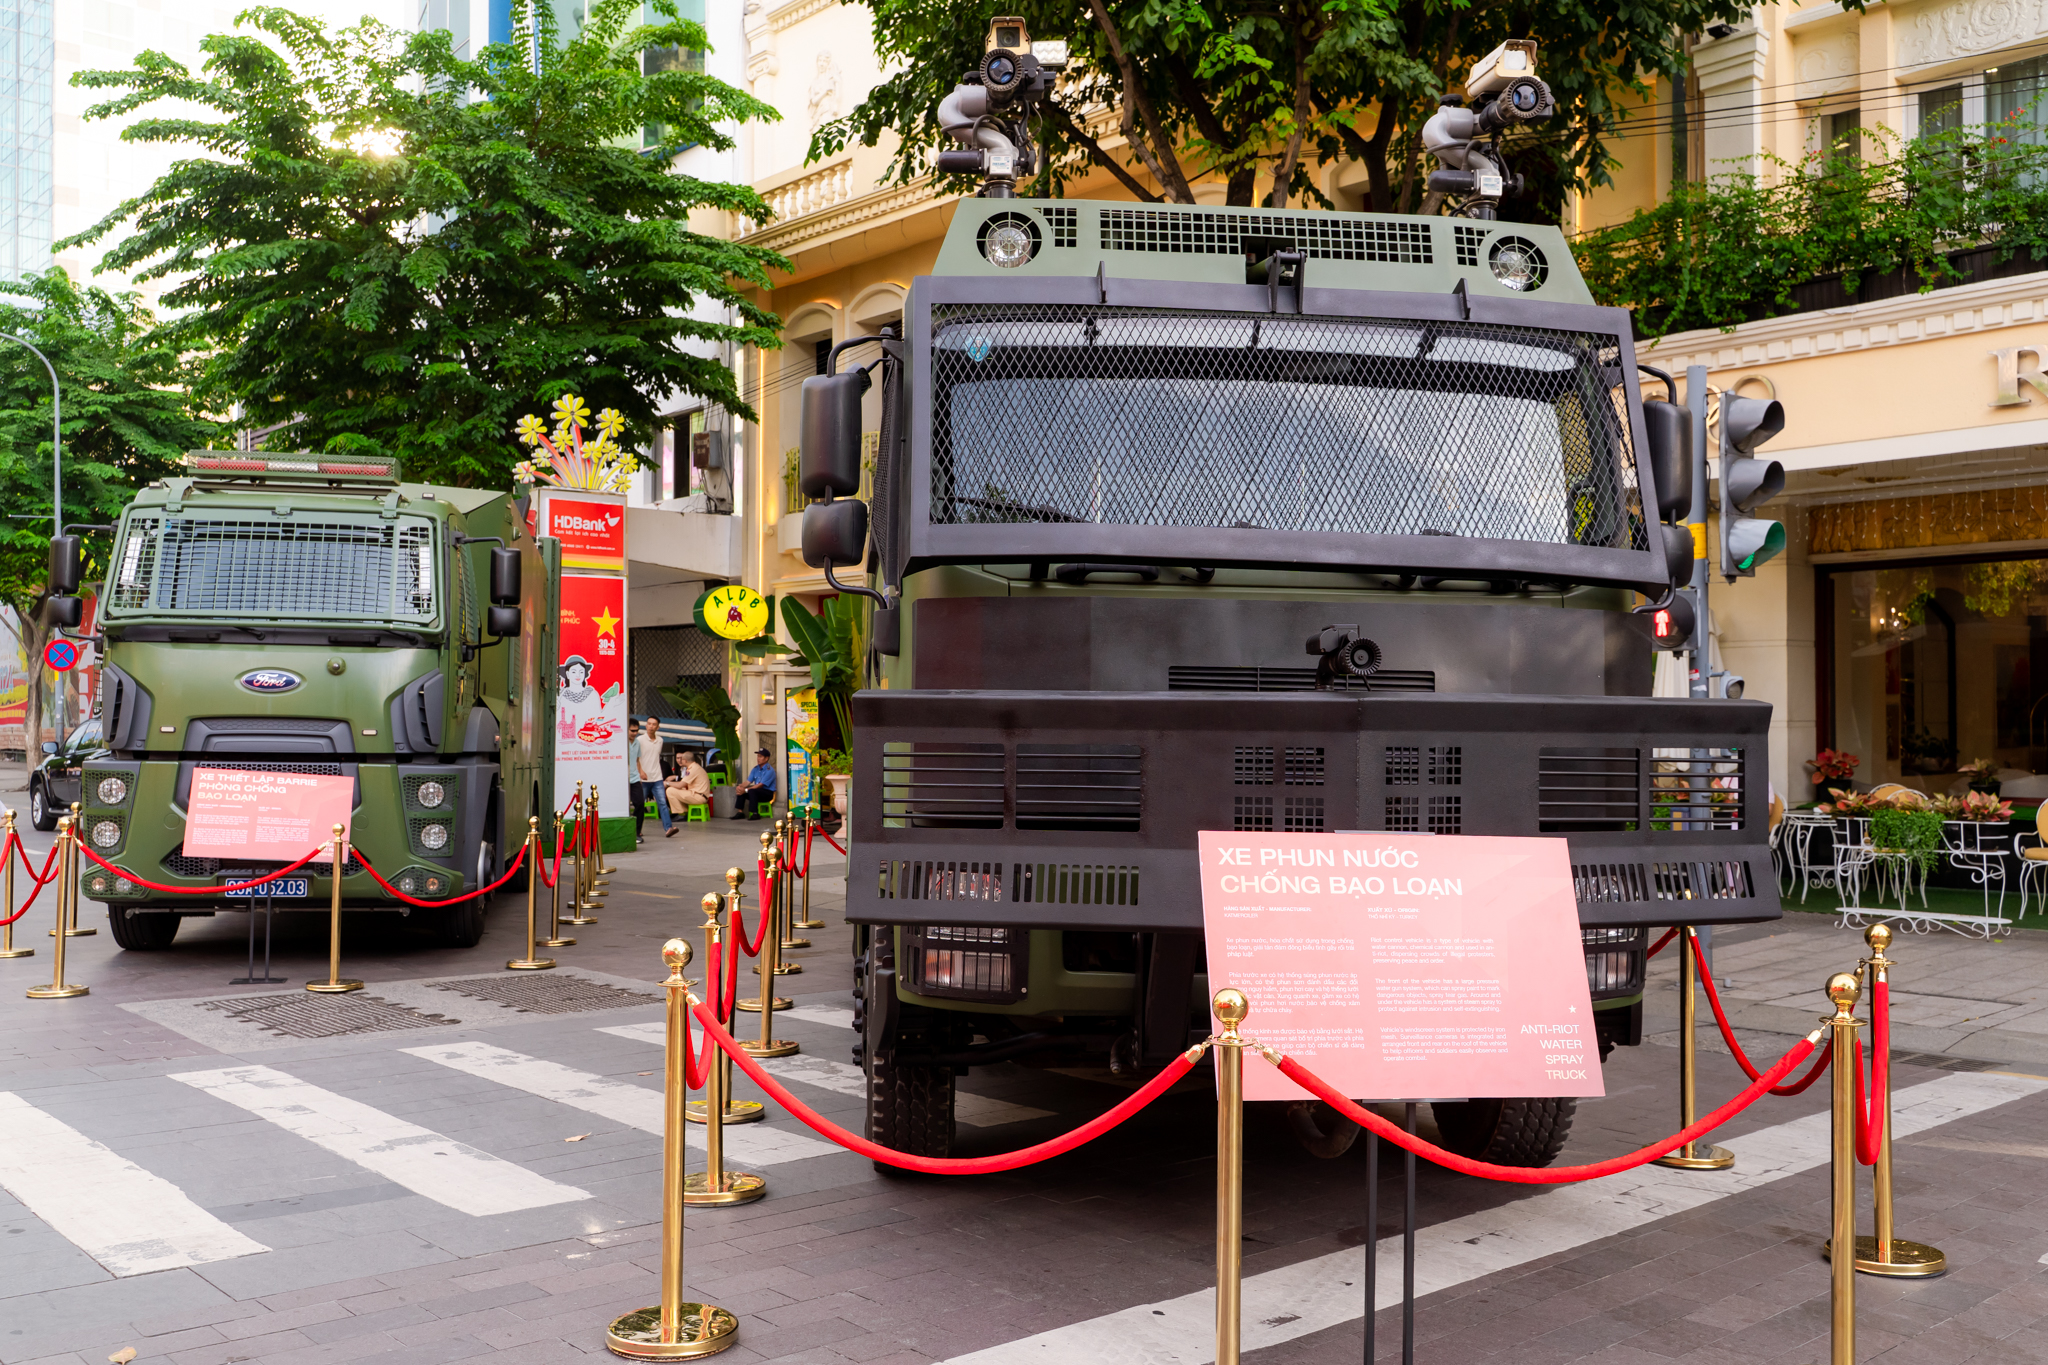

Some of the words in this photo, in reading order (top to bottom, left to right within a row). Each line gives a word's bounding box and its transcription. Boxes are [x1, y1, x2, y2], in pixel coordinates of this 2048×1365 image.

[554, 515, 606, 531] HDBank
[598, 638, 615, 648] 30-4
[253, 673, 286, 686] Ford
[218, 773, 250, 782] THIẾT
[277, 777, 318, 786] BARRIE
[199, 782, 241, 792] PHÒNG
[244, 784, 286, 794] CHỐNG
[197, 792, 222, 800] BẠO
[226, 794, 257, 803] LOẠN
[1218, 848, 1252, 866] XE
[1260, 848, 1335, 867] PHUN
[1343, 846, 1419, 868] NƯỚC
[1220, 869, 1321, 894] CHỐNG
[1329, 877, 1385, 899] BẠO
[1393, 877, 1463, 900] LOẠN
[1321, 937, 1336, 945] trong
[1373, 957, 1401, 965] preserving
[1378, 1005, 1398, 1013] protect
[1436, 1026, 1455, 1034] system
[1462, 1026, 1487, 1034] protected
[1520, 1024, 1579, 1034] ANTI-RIOT
[1467, 1033, 1494, 1041] integrated
[1382, 1040, 1406, 1048] arranged
[1540, 1040, 1583, 1049] WATER
[1383, 1054, 1404, 1062] operate
[1545, 1055, 1584, 1064] SPRAY
[1545, 1070, 1587, 1079] TRUCK
